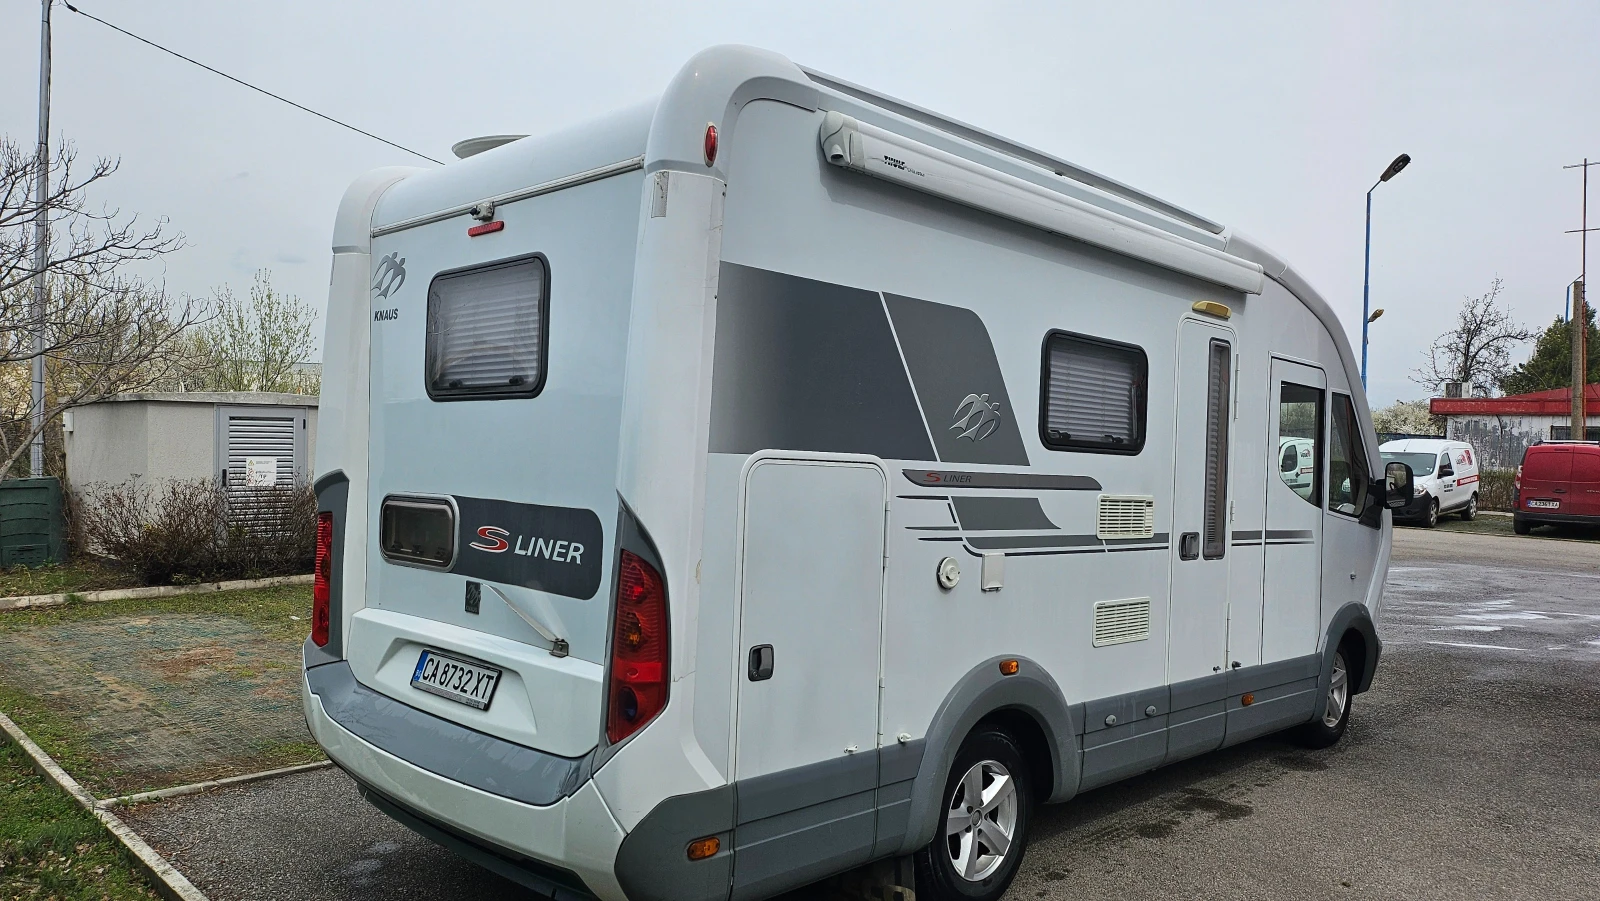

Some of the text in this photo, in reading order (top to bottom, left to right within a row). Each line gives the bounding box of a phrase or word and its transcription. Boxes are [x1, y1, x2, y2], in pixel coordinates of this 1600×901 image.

[373, 307, 399, 322] KNAUS
[923, 472, 973, 484] S LINER
[468, 525, 586, 566] S LINER
[422, 657, 441, 684] CA
[439, 662, 474, 694] 8732
[470, 671, 495, 699] XT
